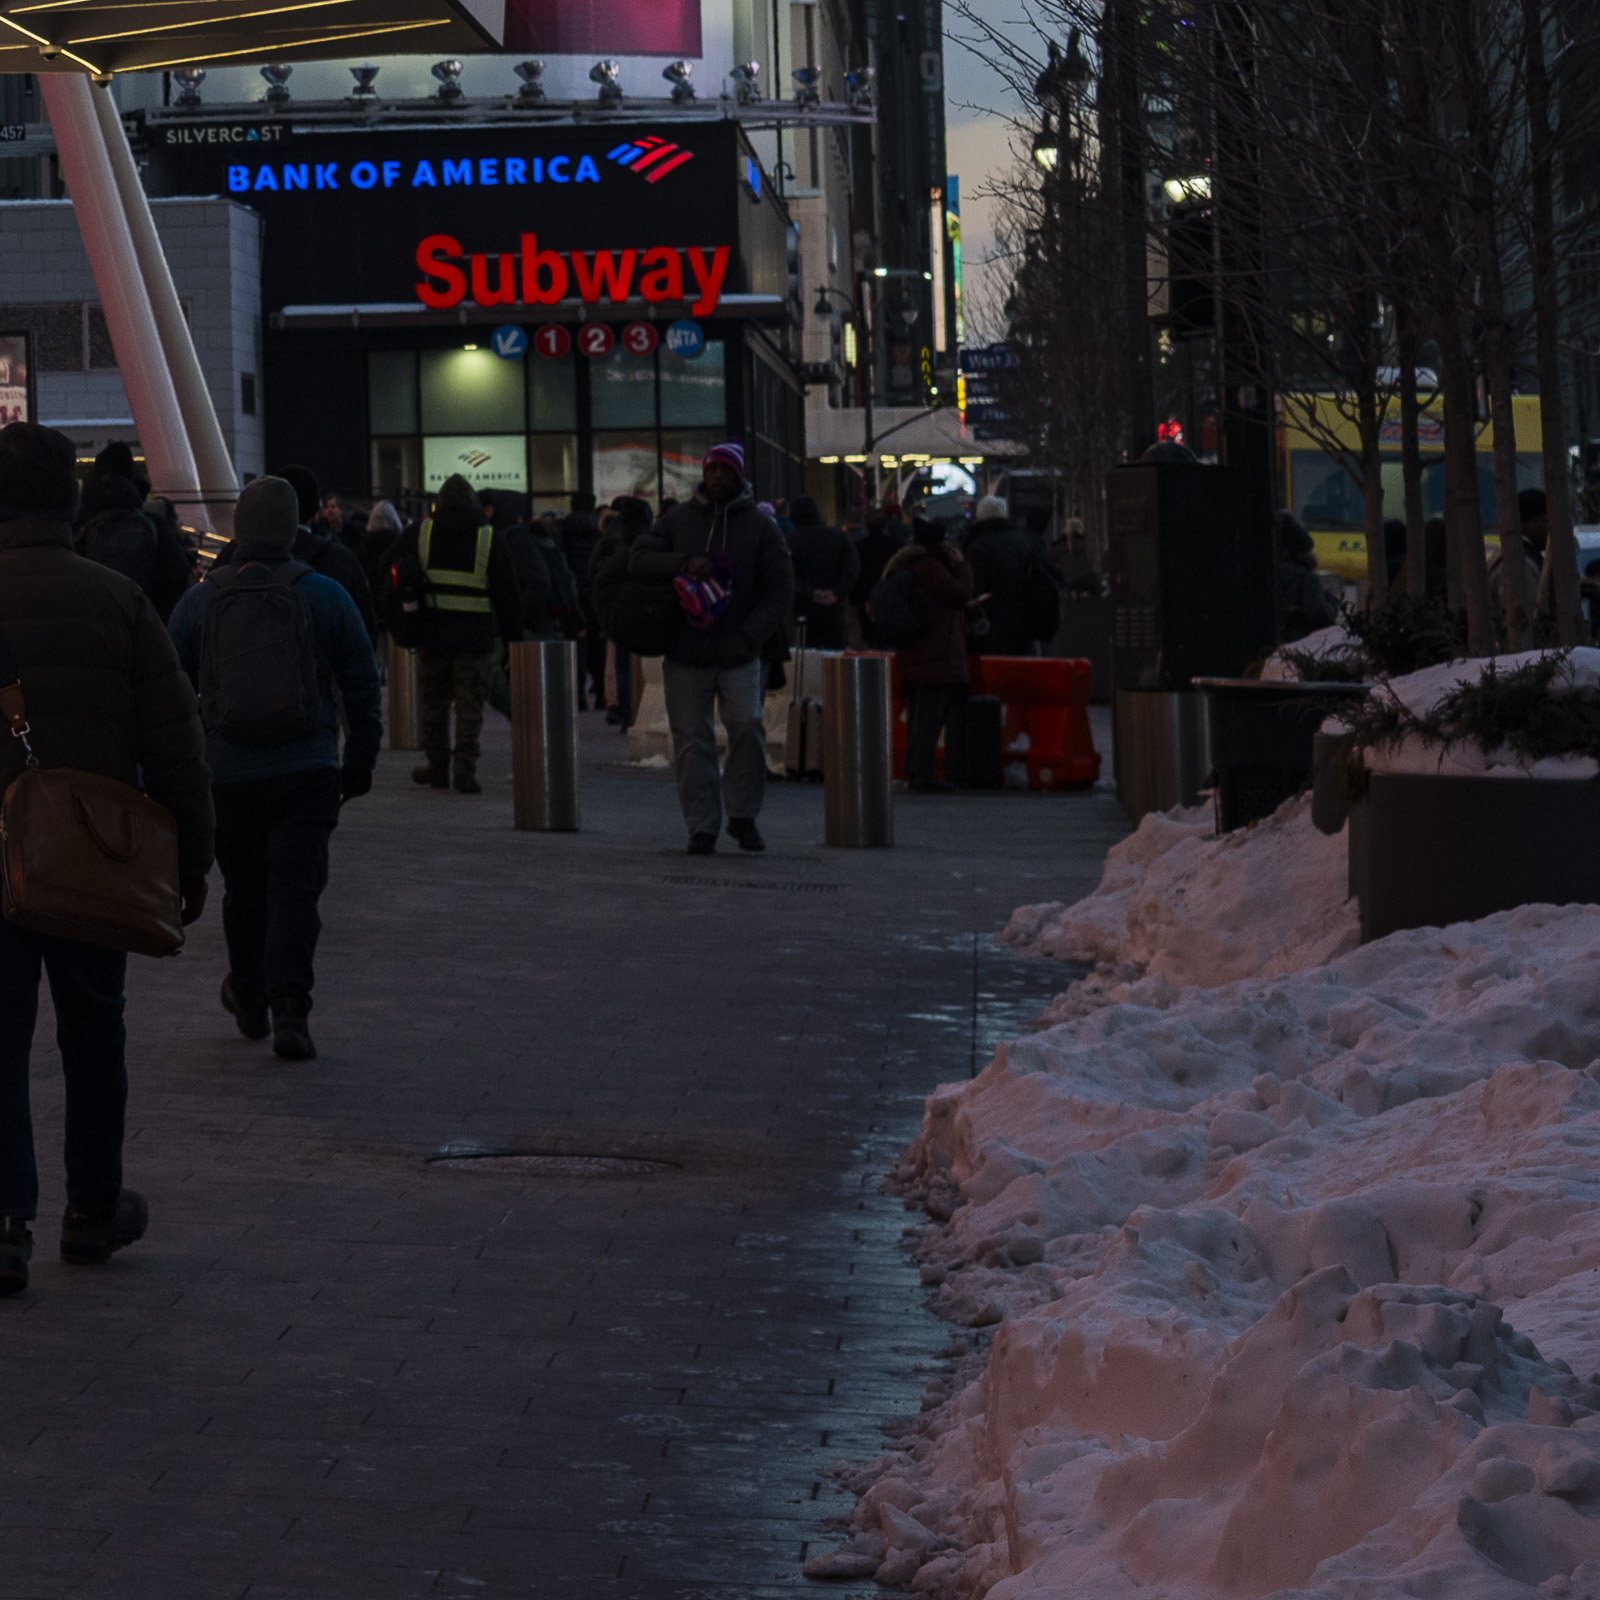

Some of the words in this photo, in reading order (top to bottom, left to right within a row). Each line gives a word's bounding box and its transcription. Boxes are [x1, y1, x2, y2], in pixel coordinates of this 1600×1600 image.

[166, 125, 283, 144] SILVERCAST
[227, 161, 340, 193] BANK
[349, 160, 402, 190] OF
[411, 155, 601, 188] AMERICA
[416, 232, 730, 316] Subway
[589, 328, 606, 353] 2
[630, 326, 650, 351] 3
